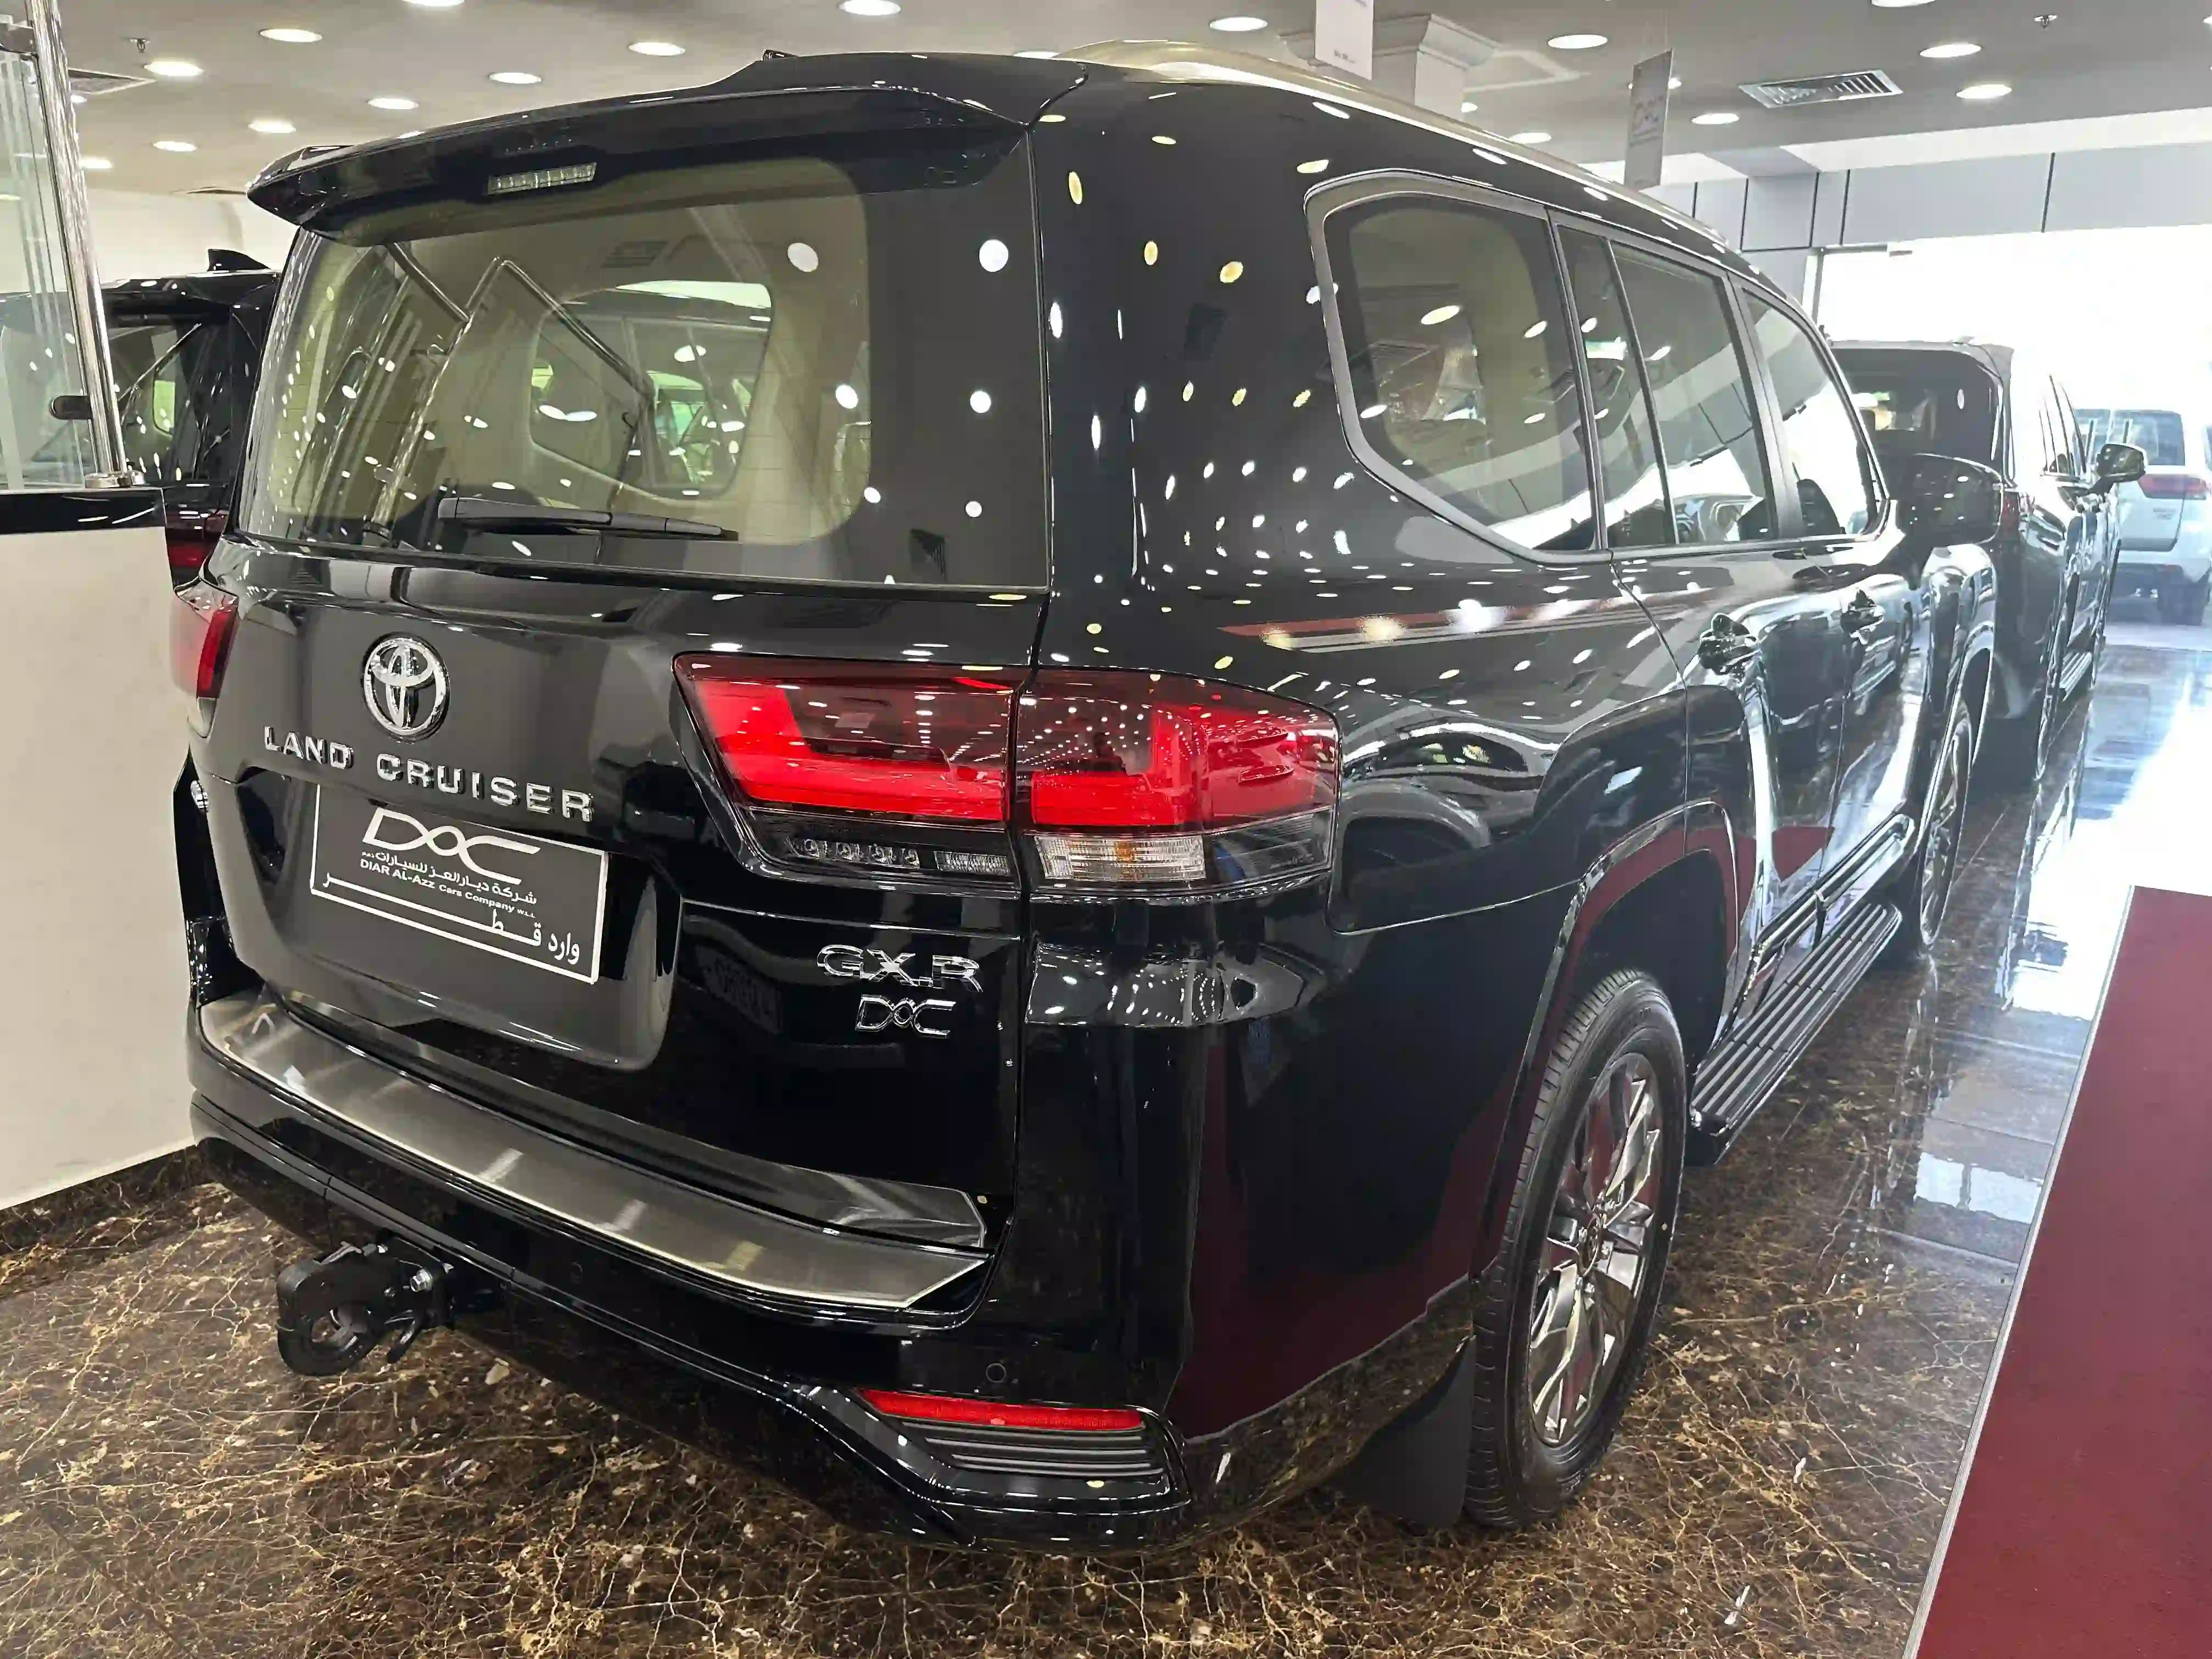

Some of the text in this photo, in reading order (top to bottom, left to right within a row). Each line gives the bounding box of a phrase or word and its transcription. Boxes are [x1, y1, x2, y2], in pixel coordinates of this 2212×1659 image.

[264, 725, 595, 823] LAND CRUISER
[360, 858, 390, 875] DIAR
[439, 884, 462, 897] Cars
[465, 891, 515, 913] Company
[491, 882, 537, 904] شركة
[548, 932, 580, 965] وارد
